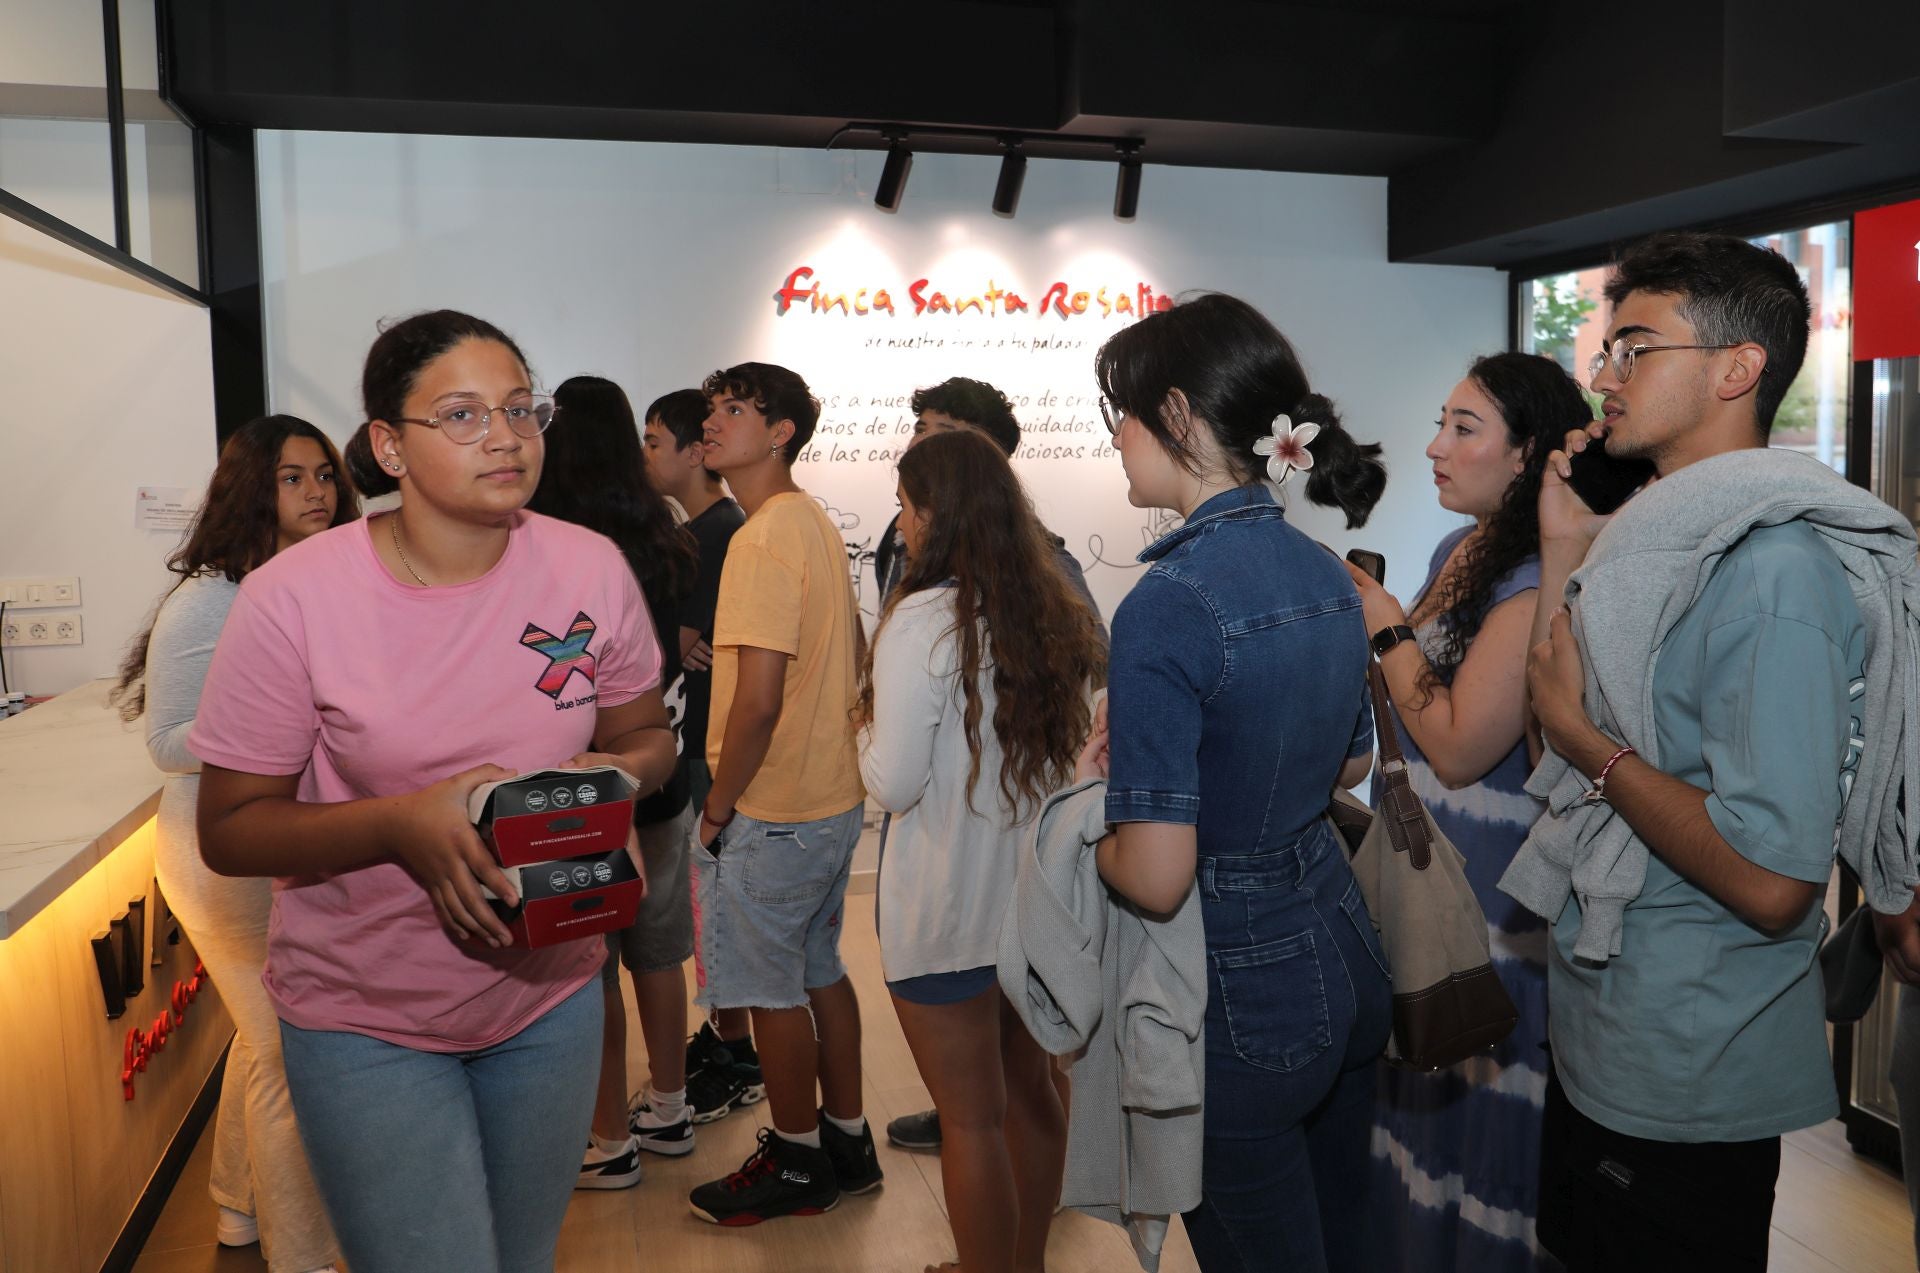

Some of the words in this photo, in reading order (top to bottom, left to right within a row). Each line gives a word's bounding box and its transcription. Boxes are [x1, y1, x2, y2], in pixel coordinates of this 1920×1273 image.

[908, 279, 1028, 318] Santa
[887, 331, 945, 349] nuestra
[1037, 389, 1058, 408] de
[815, 418, 857, 436] ños
[865, 416, 887, 436] de
[1018, 415, 1098, 435] uidados,
[799, 443, 822, 463] de
[829, 442, 861, 463] las
[1014, 440, 1085, 460] liciosas
[554, 700, 575, 711] blue
